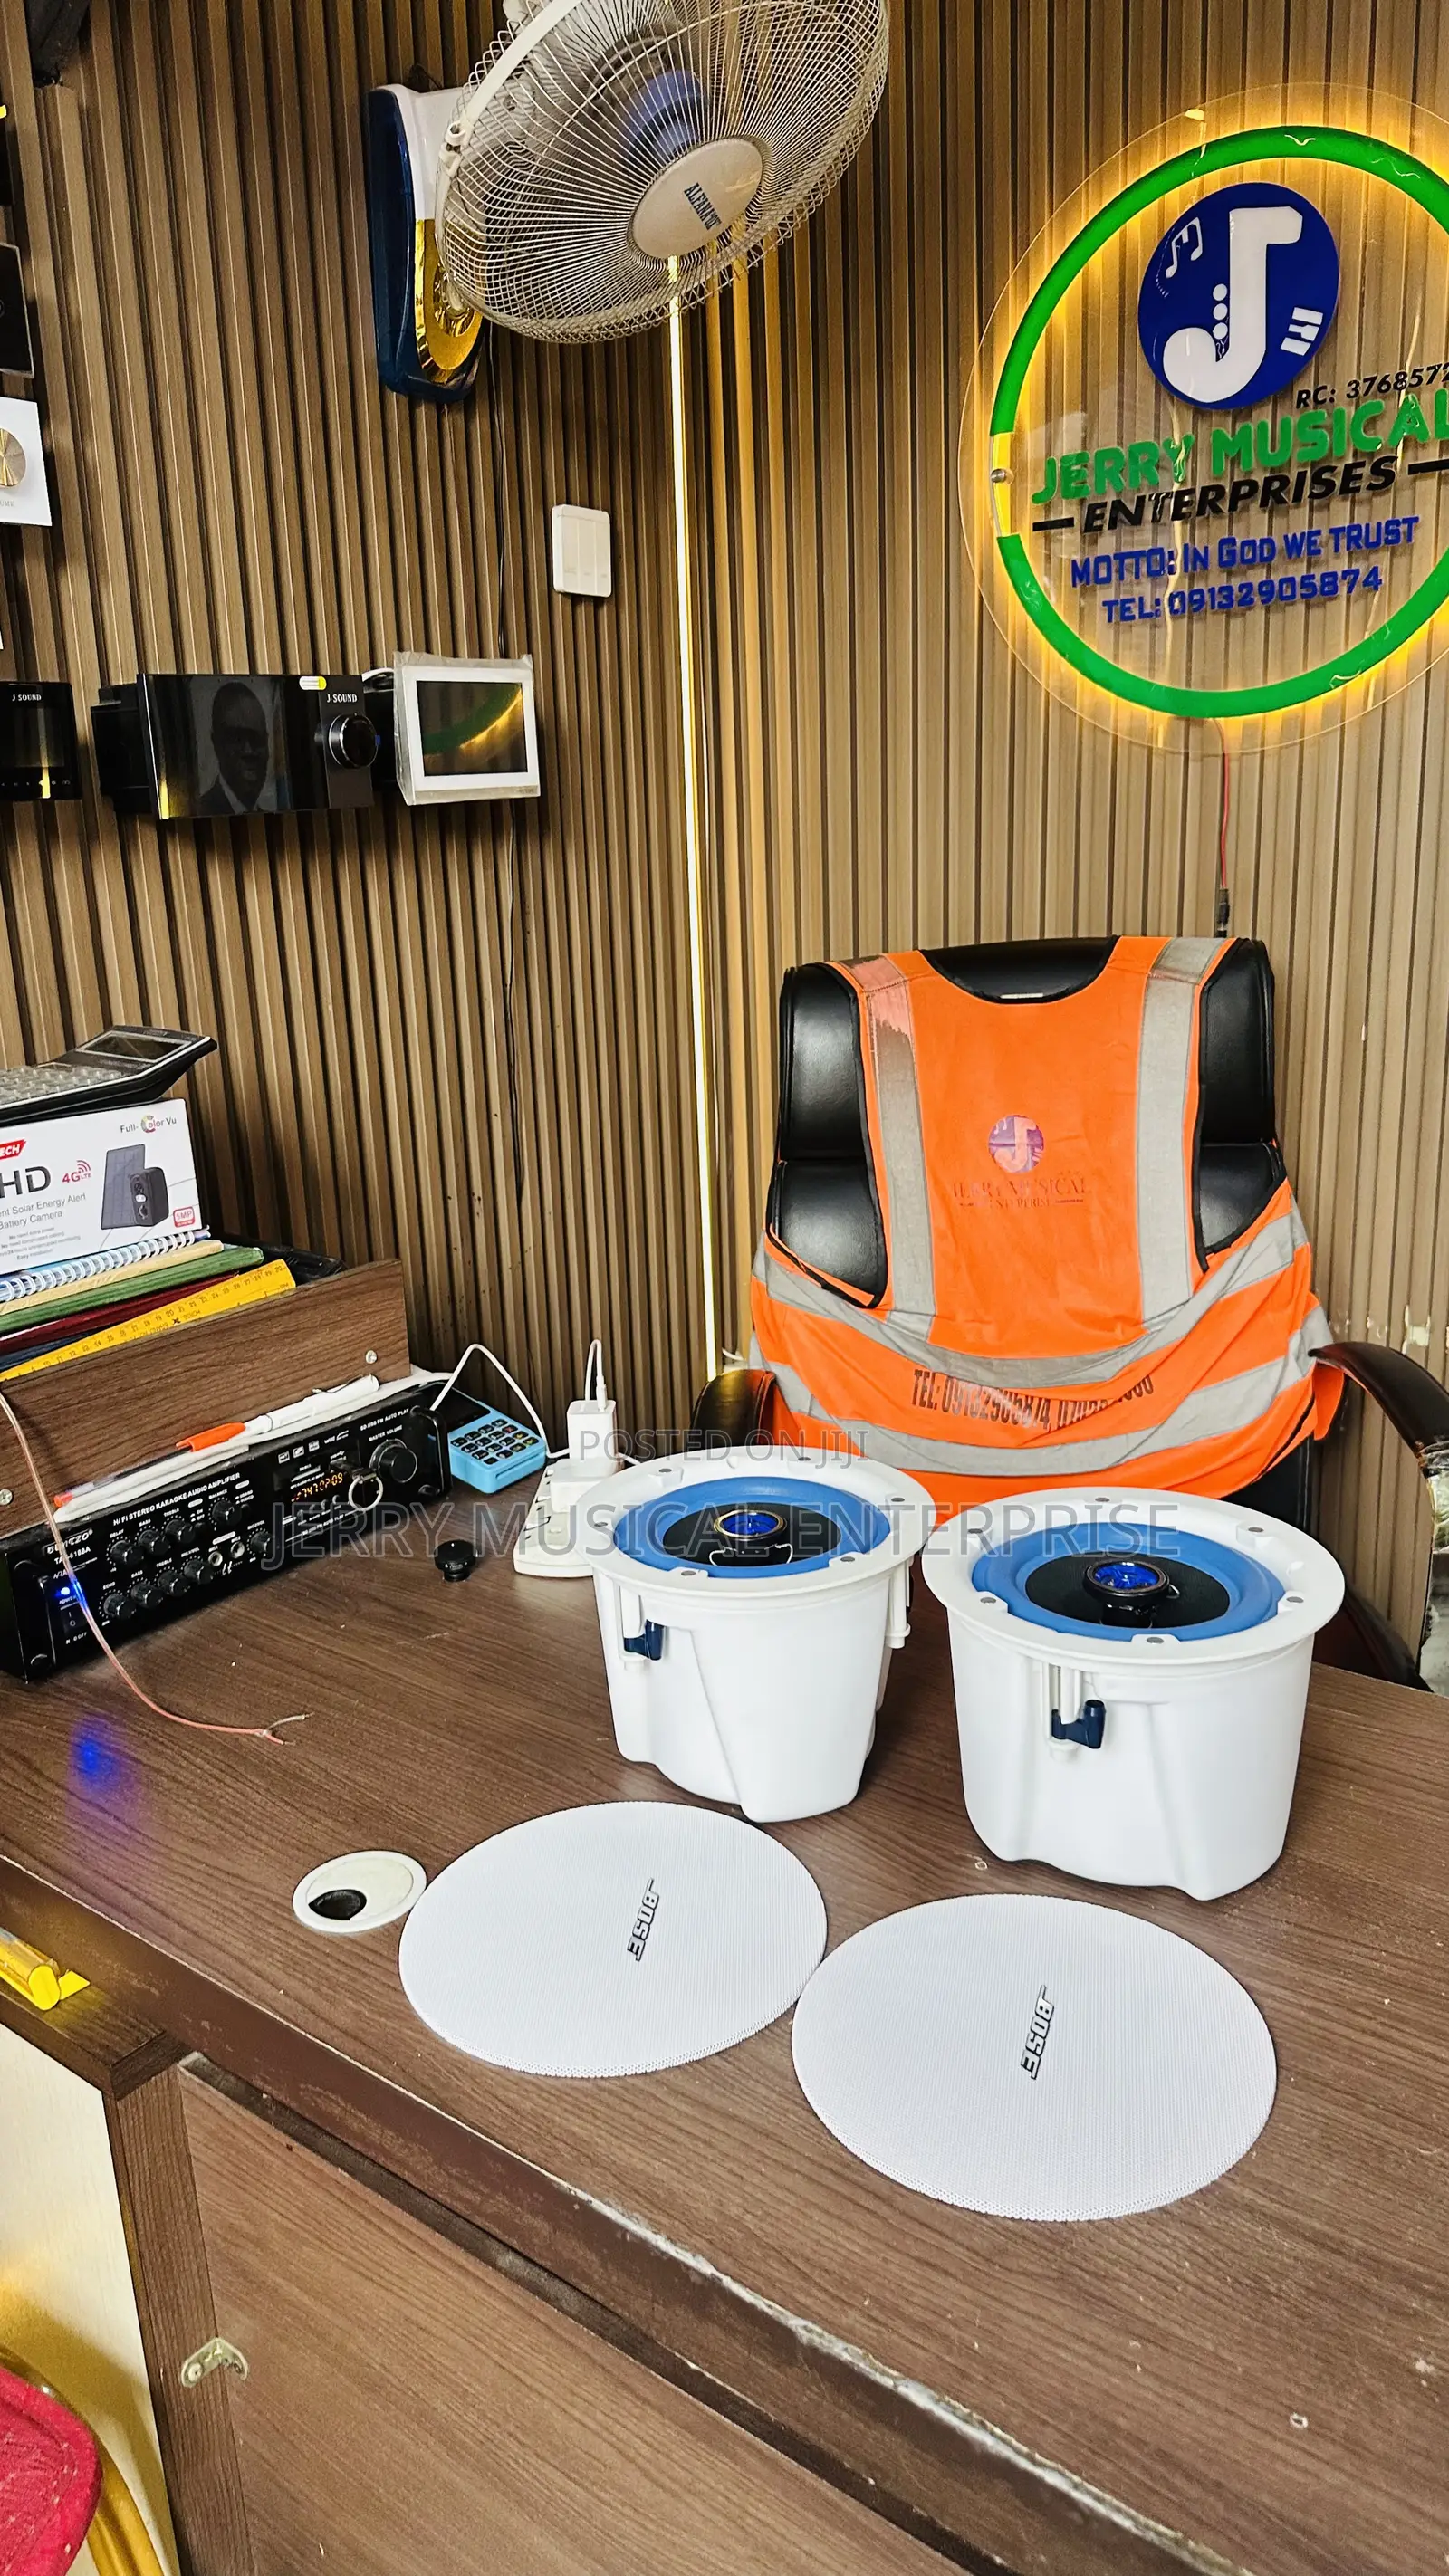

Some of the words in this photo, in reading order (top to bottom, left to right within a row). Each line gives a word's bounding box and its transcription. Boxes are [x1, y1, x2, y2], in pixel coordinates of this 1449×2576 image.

[1296, 386, 1336, 408] RC:
[1032, 433, 1195, 505] JERRY
[1211, 387, 1449, 477] MUSICAL
[1082, 455, 1399, 534] ENTERPRISES
[1070, 547, 1176, 589] MOTTO:
[1283, 529, 1321, 559] WE
[1329, 516, 1419, 551] TRUST
[1102, 596, 1161, 623] TEL:
[1168, 565, 1382, 615] 09132905874
[332, 694, 358, 703] SOUND
[12, 1204, 34, 1215] Solar
[36, 1199, 65, 1209] Energy
[67, 1193, 86, 1203] Alert
[29, 1211, 63, 1223] Camera
[913, 1369, 939, 1409] TEL:
[129, 1504, 155, 1521] STEREO
[156, 1492, 187, 1510] KARAOKE
[187, 1485, 207, 1497] AUDIO
[208, 1472, 240, 1490] AMPLIFIER
[627, 1877, 659, 1962] BOSE
[1020, 1984, 1054, 2080] BOSE
